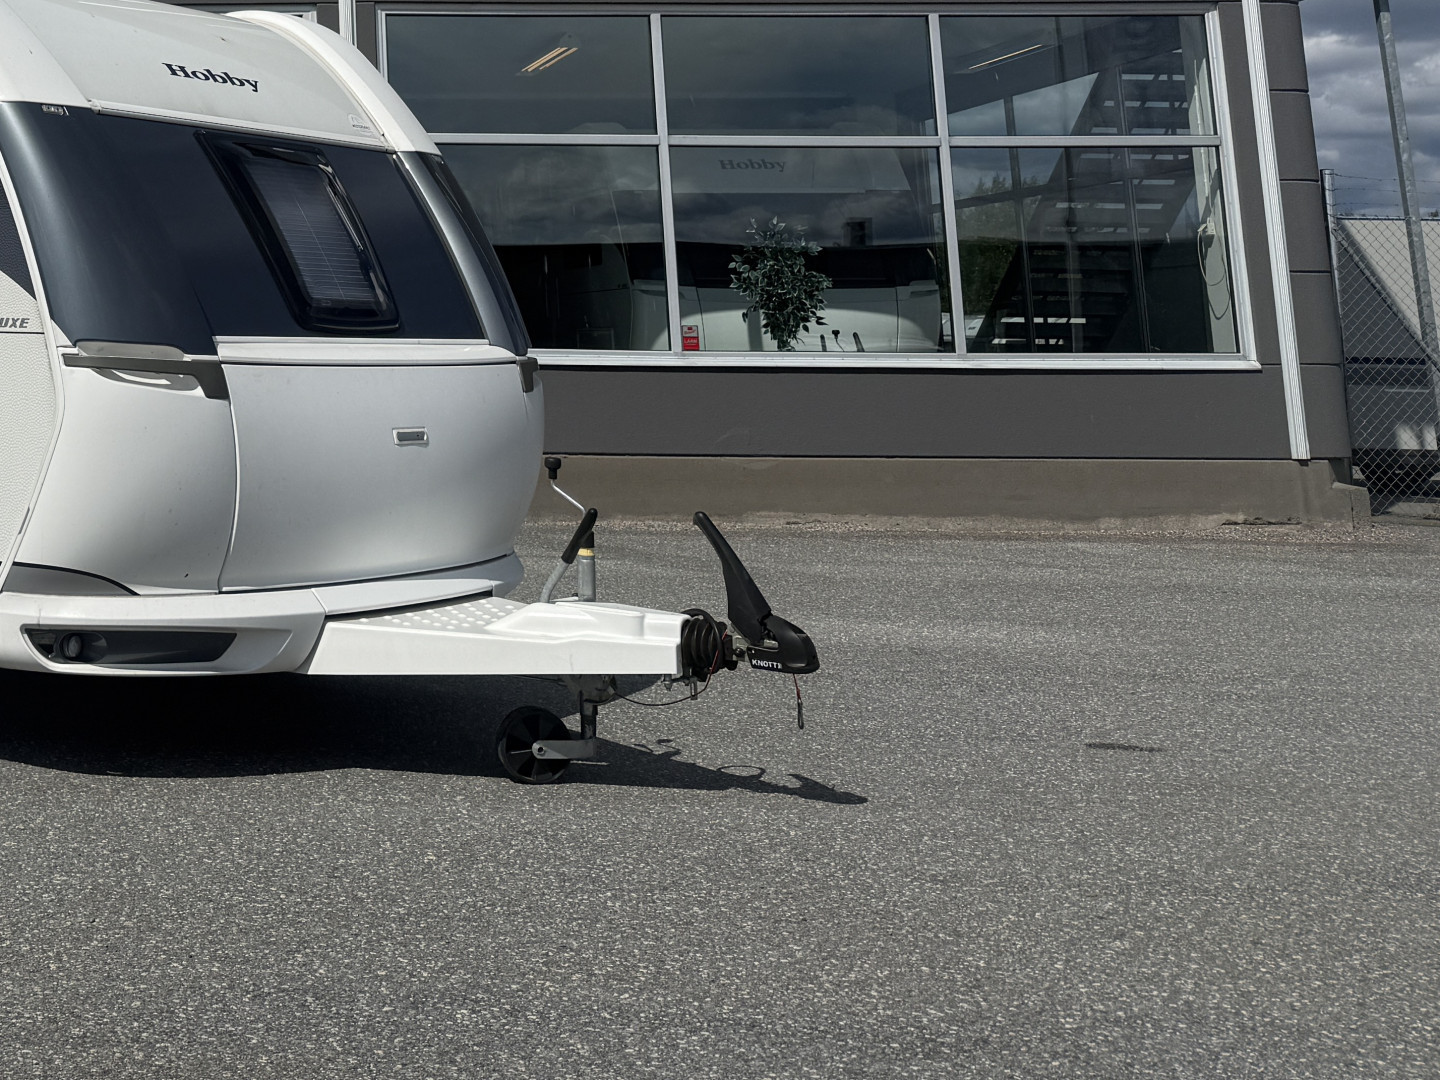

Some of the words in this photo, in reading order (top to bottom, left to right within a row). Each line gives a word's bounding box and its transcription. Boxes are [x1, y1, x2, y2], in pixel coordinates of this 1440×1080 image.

[161, 62, 259, 93] Hobby
[719, 158, 785, 173] Hobby
[751, 659, 777, 669] KNOTT
